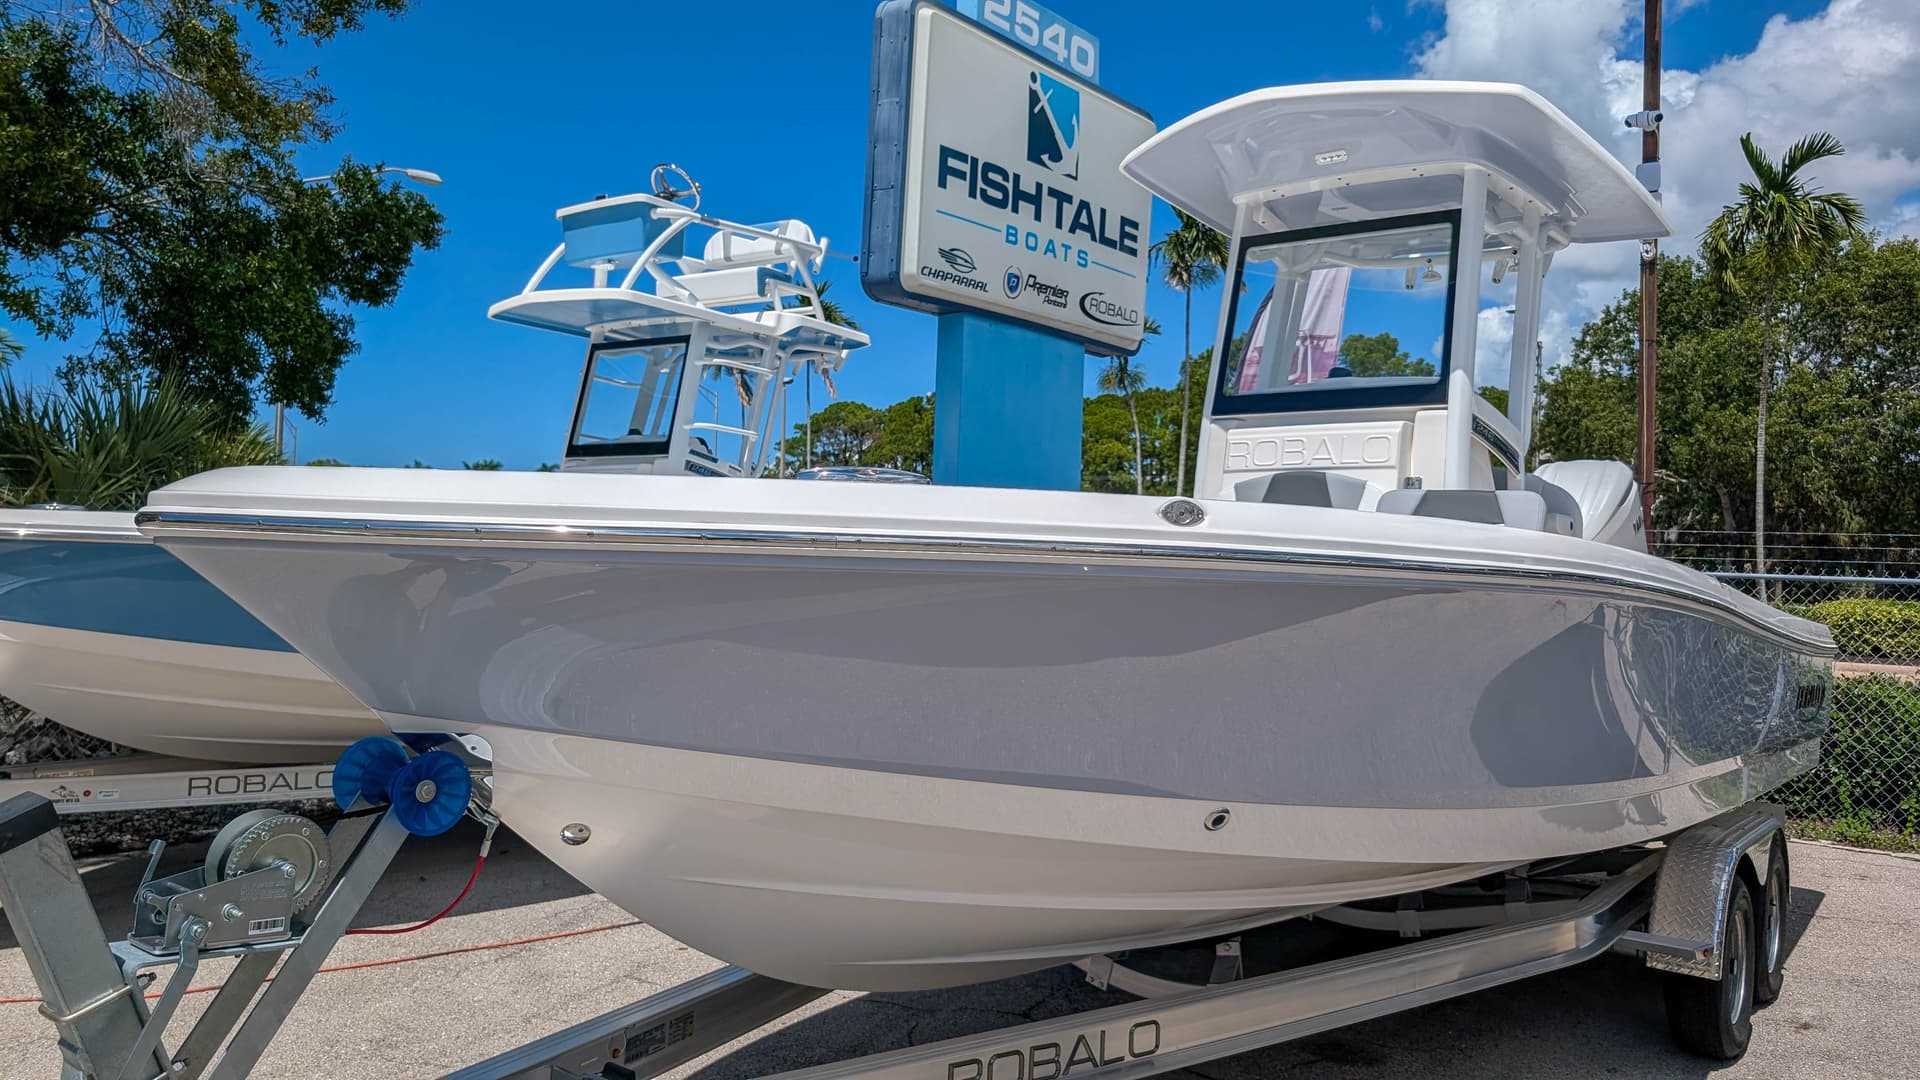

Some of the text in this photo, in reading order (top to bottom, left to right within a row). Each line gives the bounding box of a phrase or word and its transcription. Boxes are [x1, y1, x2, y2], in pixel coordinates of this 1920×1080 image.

[984, 0, 1095, 77] 2540
[937, 144, 1140, 258] FISHTALE
[1005, 224, 1089, 269] BOATS
[920, 265, 989, 293] CHAPARRAL
[1089, 296, 1138, 323] ROBALO
[1226, 434, 1393, 469] ROBALO
[948, 1019, 1161, 1080] ROBALO
